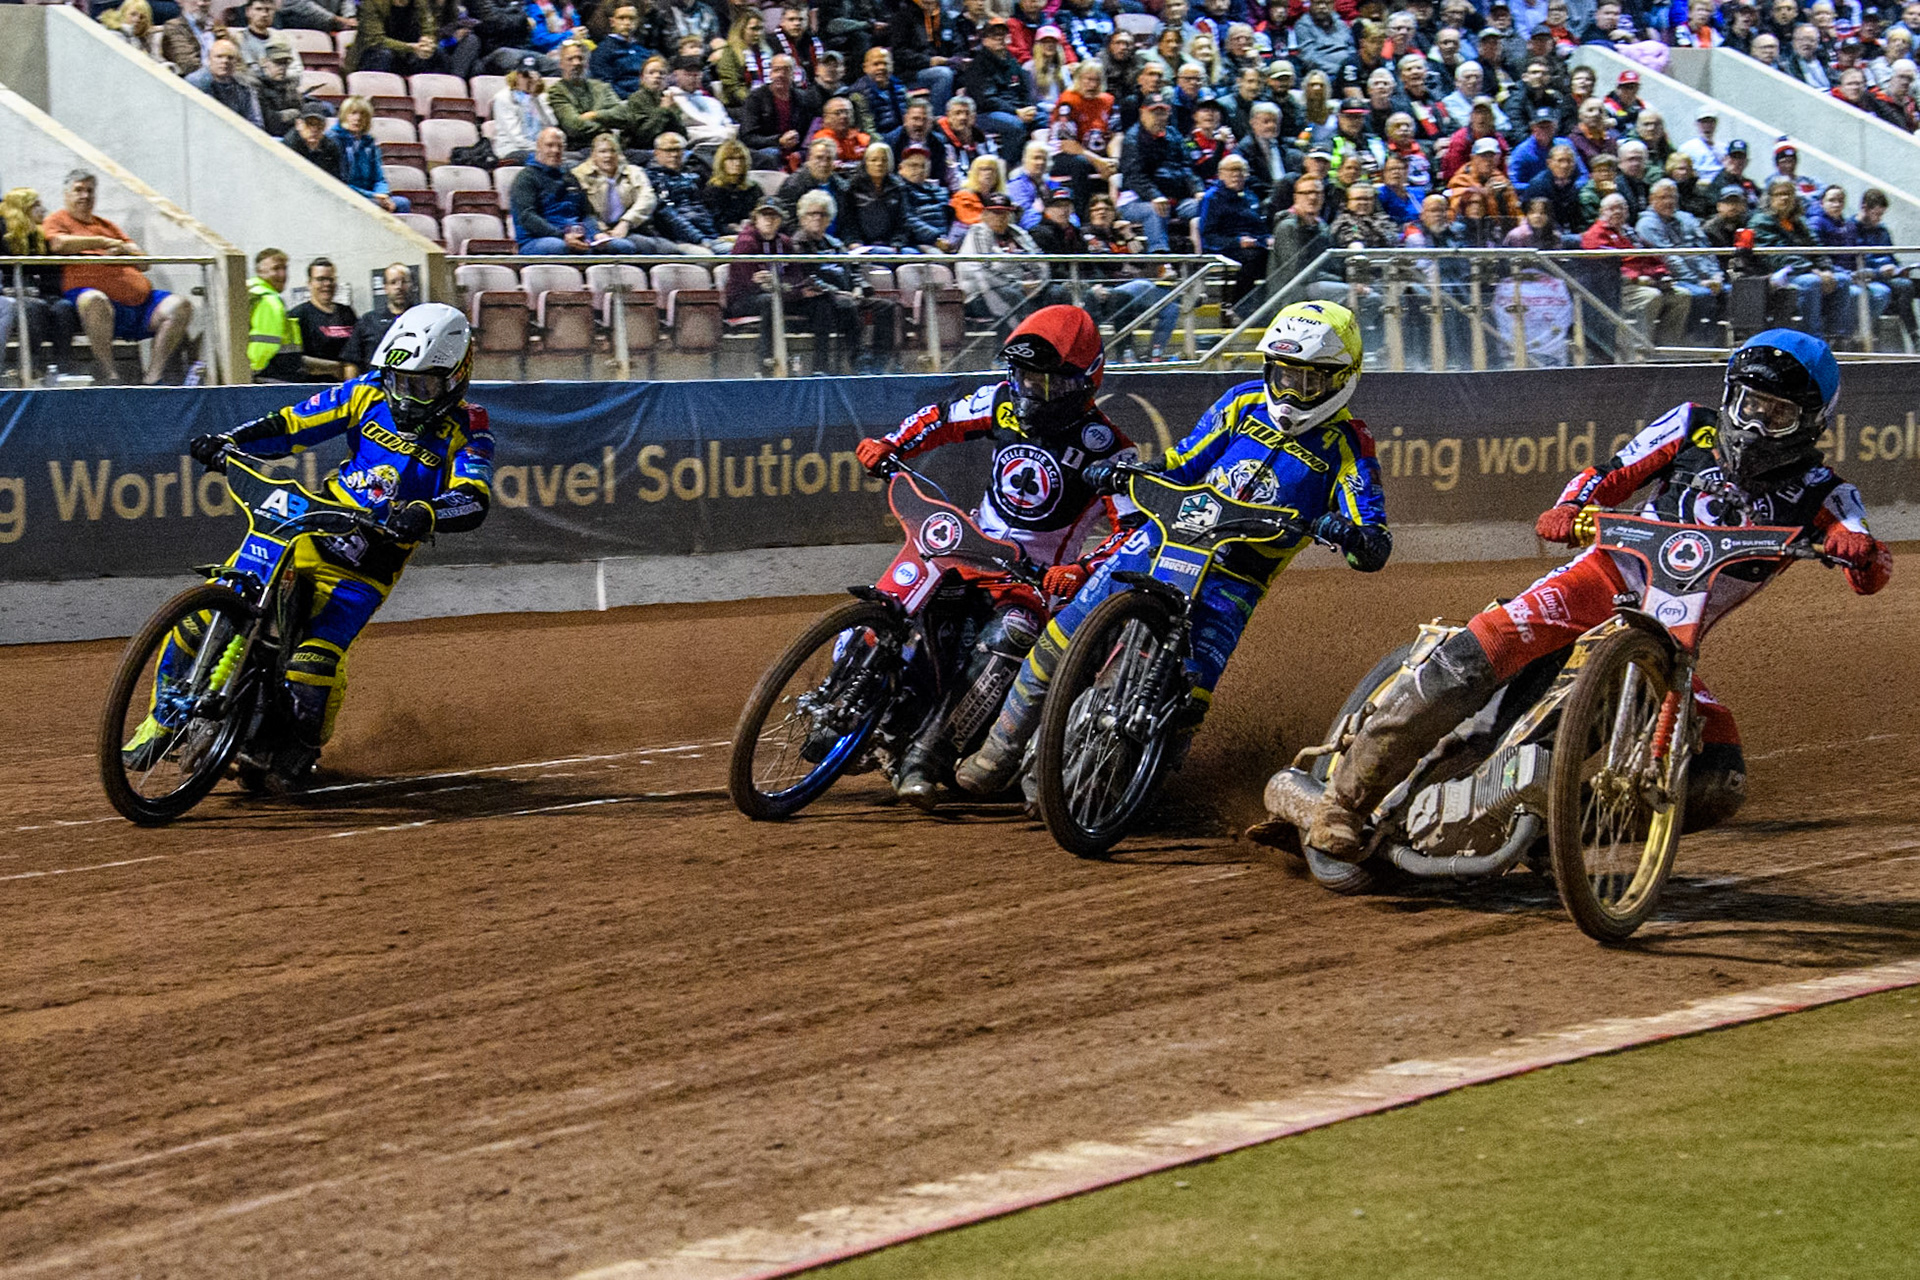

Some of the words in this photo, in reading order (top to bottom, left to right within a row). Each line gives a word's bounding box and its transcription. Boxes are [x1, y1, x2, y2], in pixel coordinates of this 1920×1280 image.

[999, 448, 1026, 466] BELLE
[1027, 450, 1049, 466] VUE
[1374, 426, 1462, 491] ring
[1477, 421, 1596, 475] world
[1858, 411, 1920, 462] sol
[492, 446, 615, 509] avel
